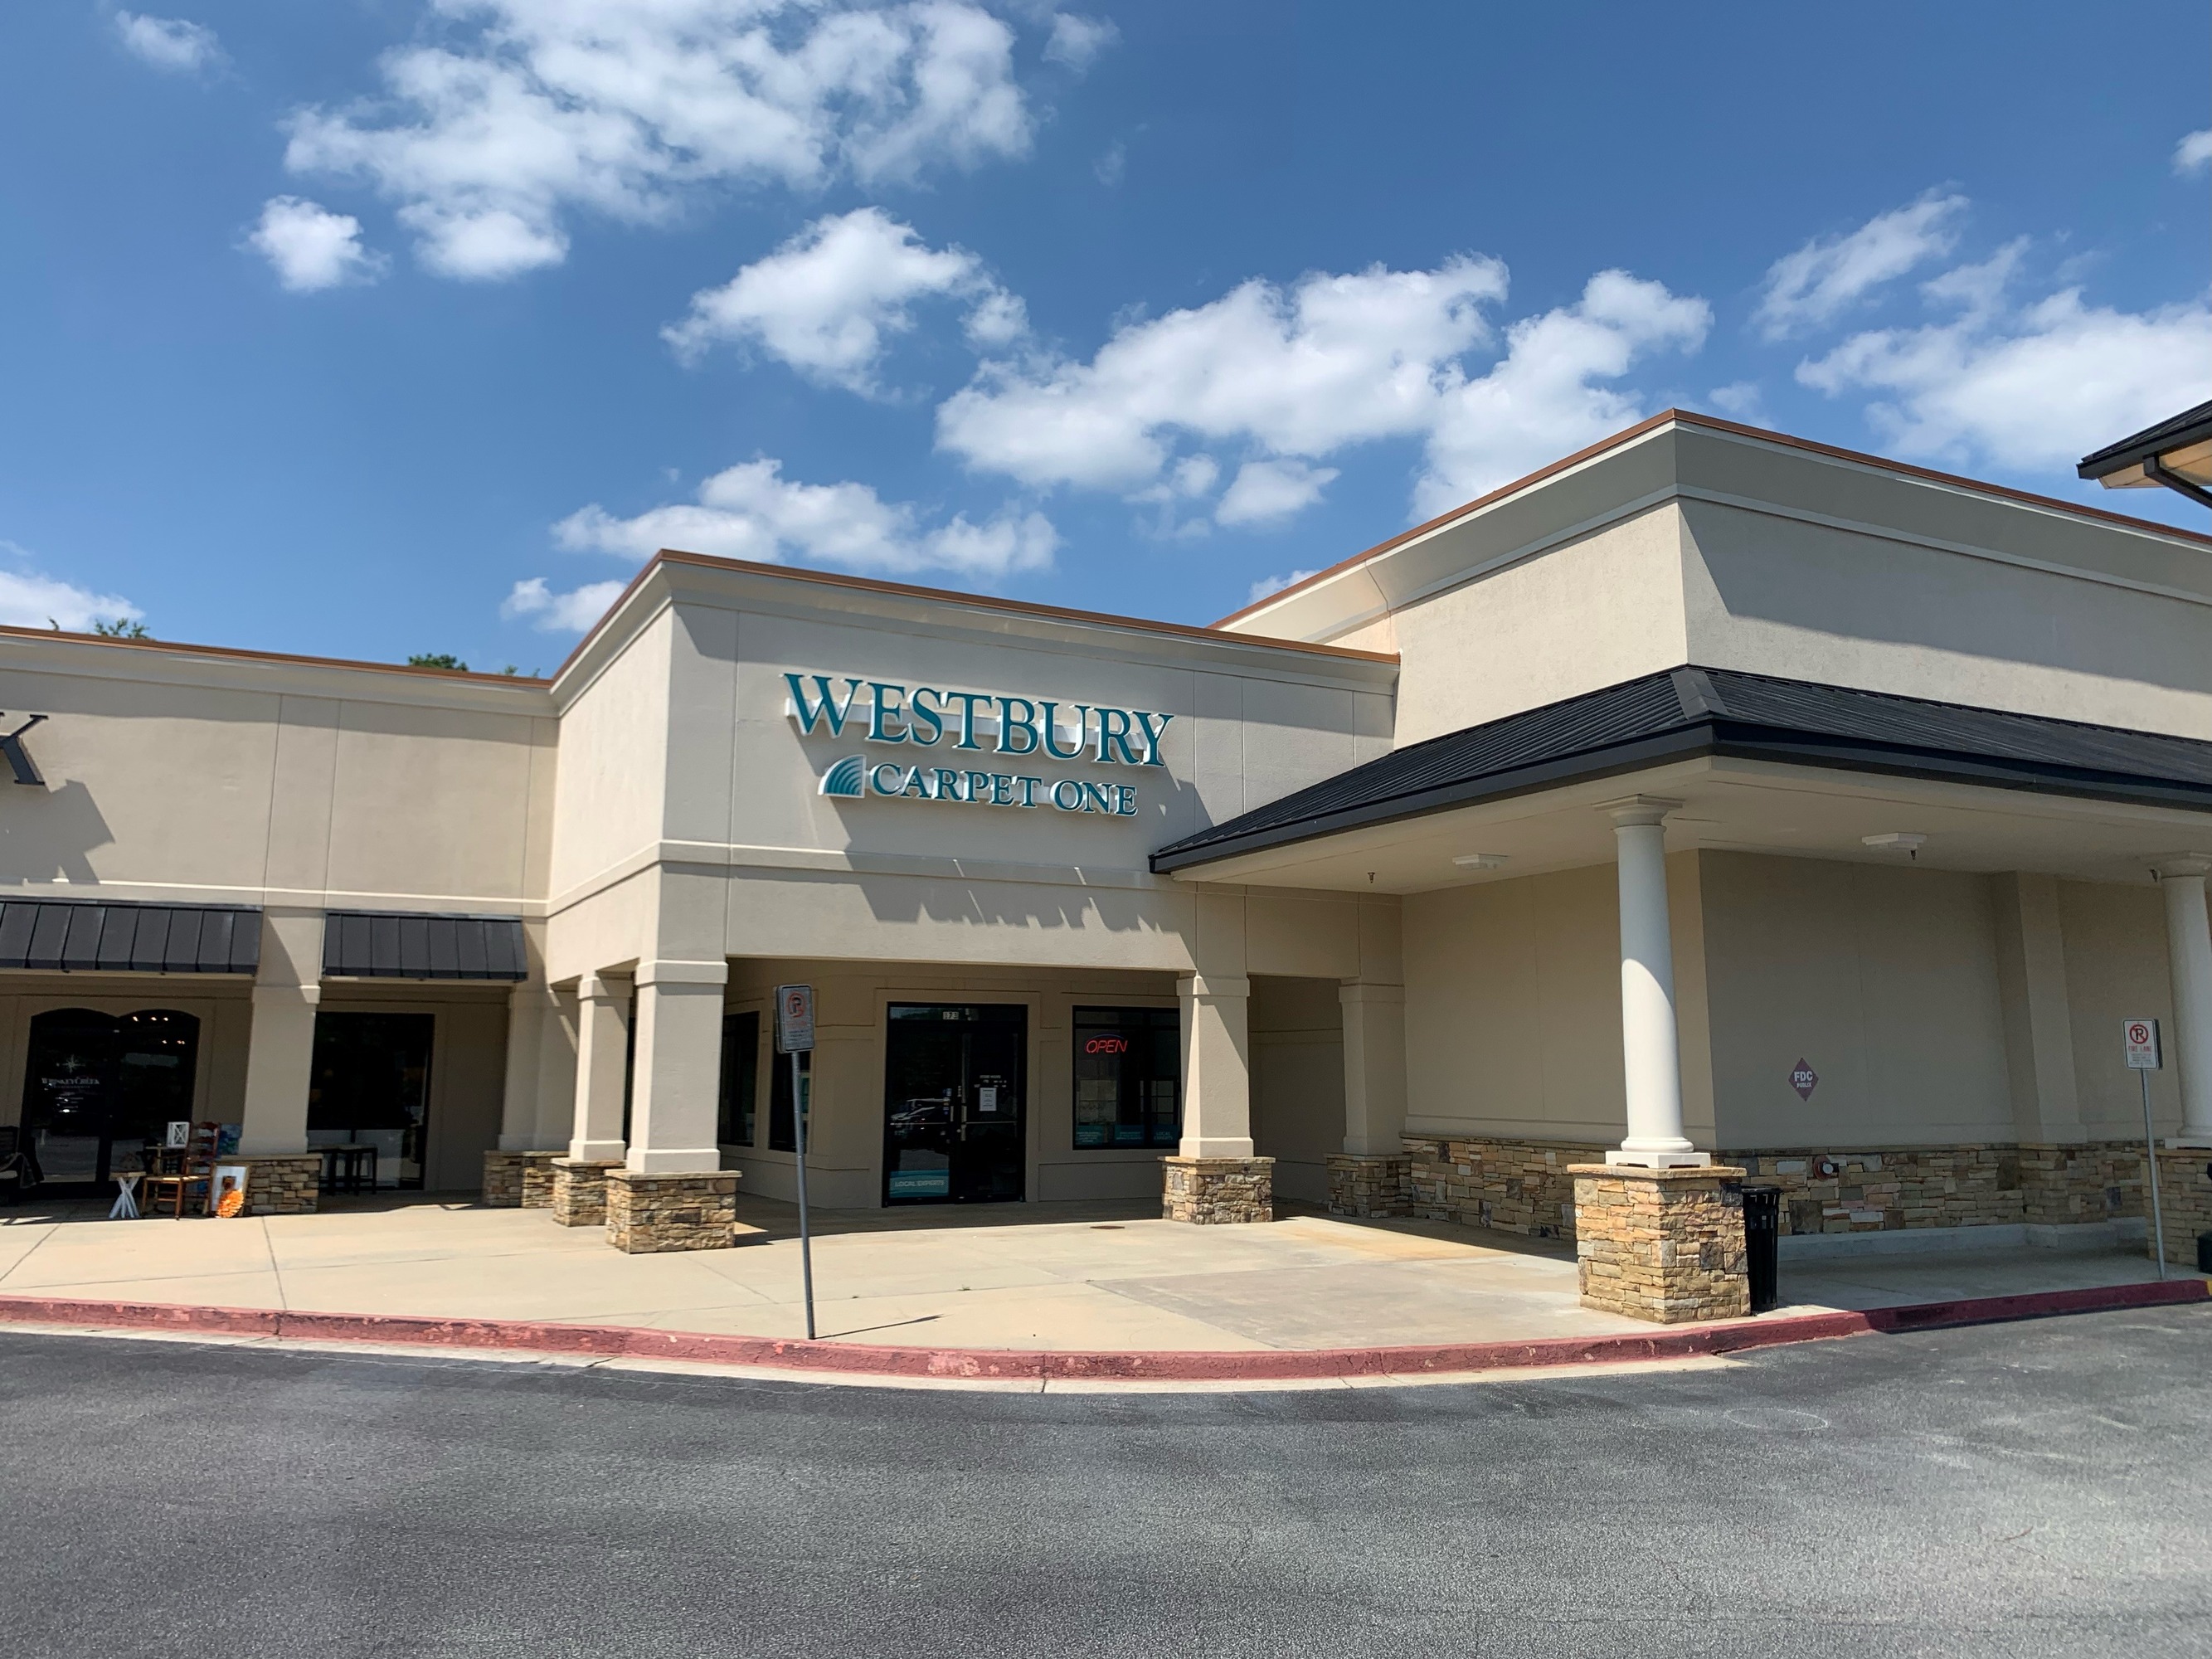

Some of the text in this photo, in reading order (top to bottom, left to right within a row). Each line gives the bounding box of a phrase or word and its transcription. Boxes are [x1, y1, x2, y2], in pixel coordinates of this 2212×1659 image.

[781, 673, 1174, 766] WESTBURY
[870, 762, 1137, 817] CARPET ONE
[1086, 1039, 1128, 1053] OPEN
[1794, 1070, 1813, 1082] FDC
